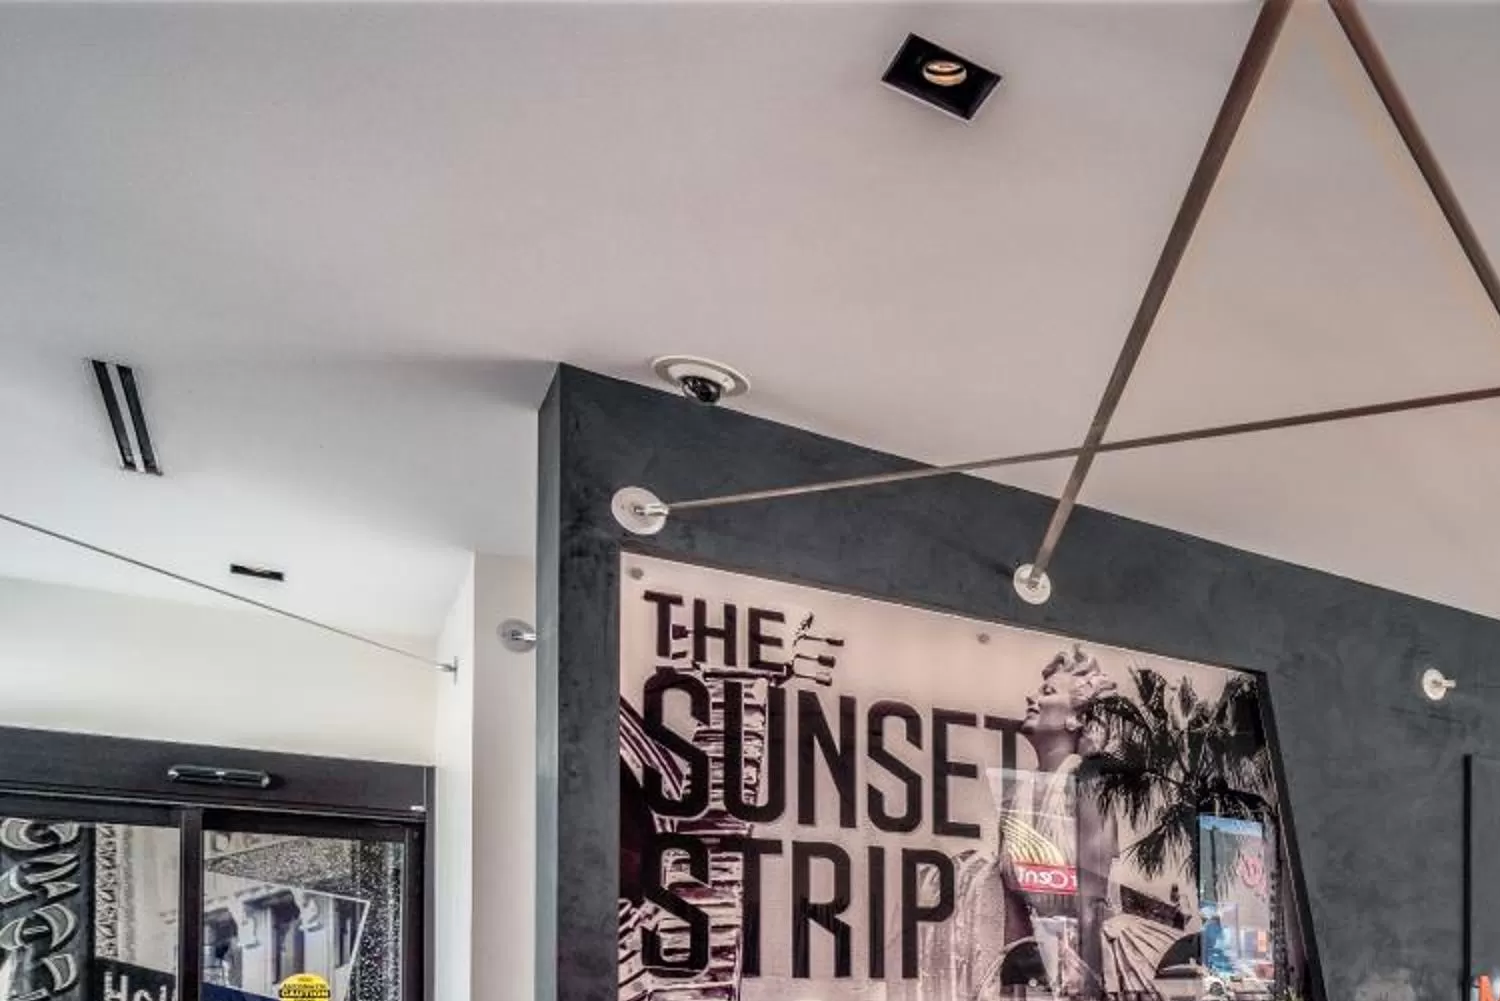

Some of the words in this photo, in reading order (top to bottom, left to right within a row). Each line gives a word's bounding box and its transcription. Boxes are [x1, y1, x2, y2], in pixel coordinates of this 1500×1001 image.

[643, 590, 787, 671] THE
[642, 666, 1027, 841] SUNSET
[641, 834, 956, 979] STRIP
